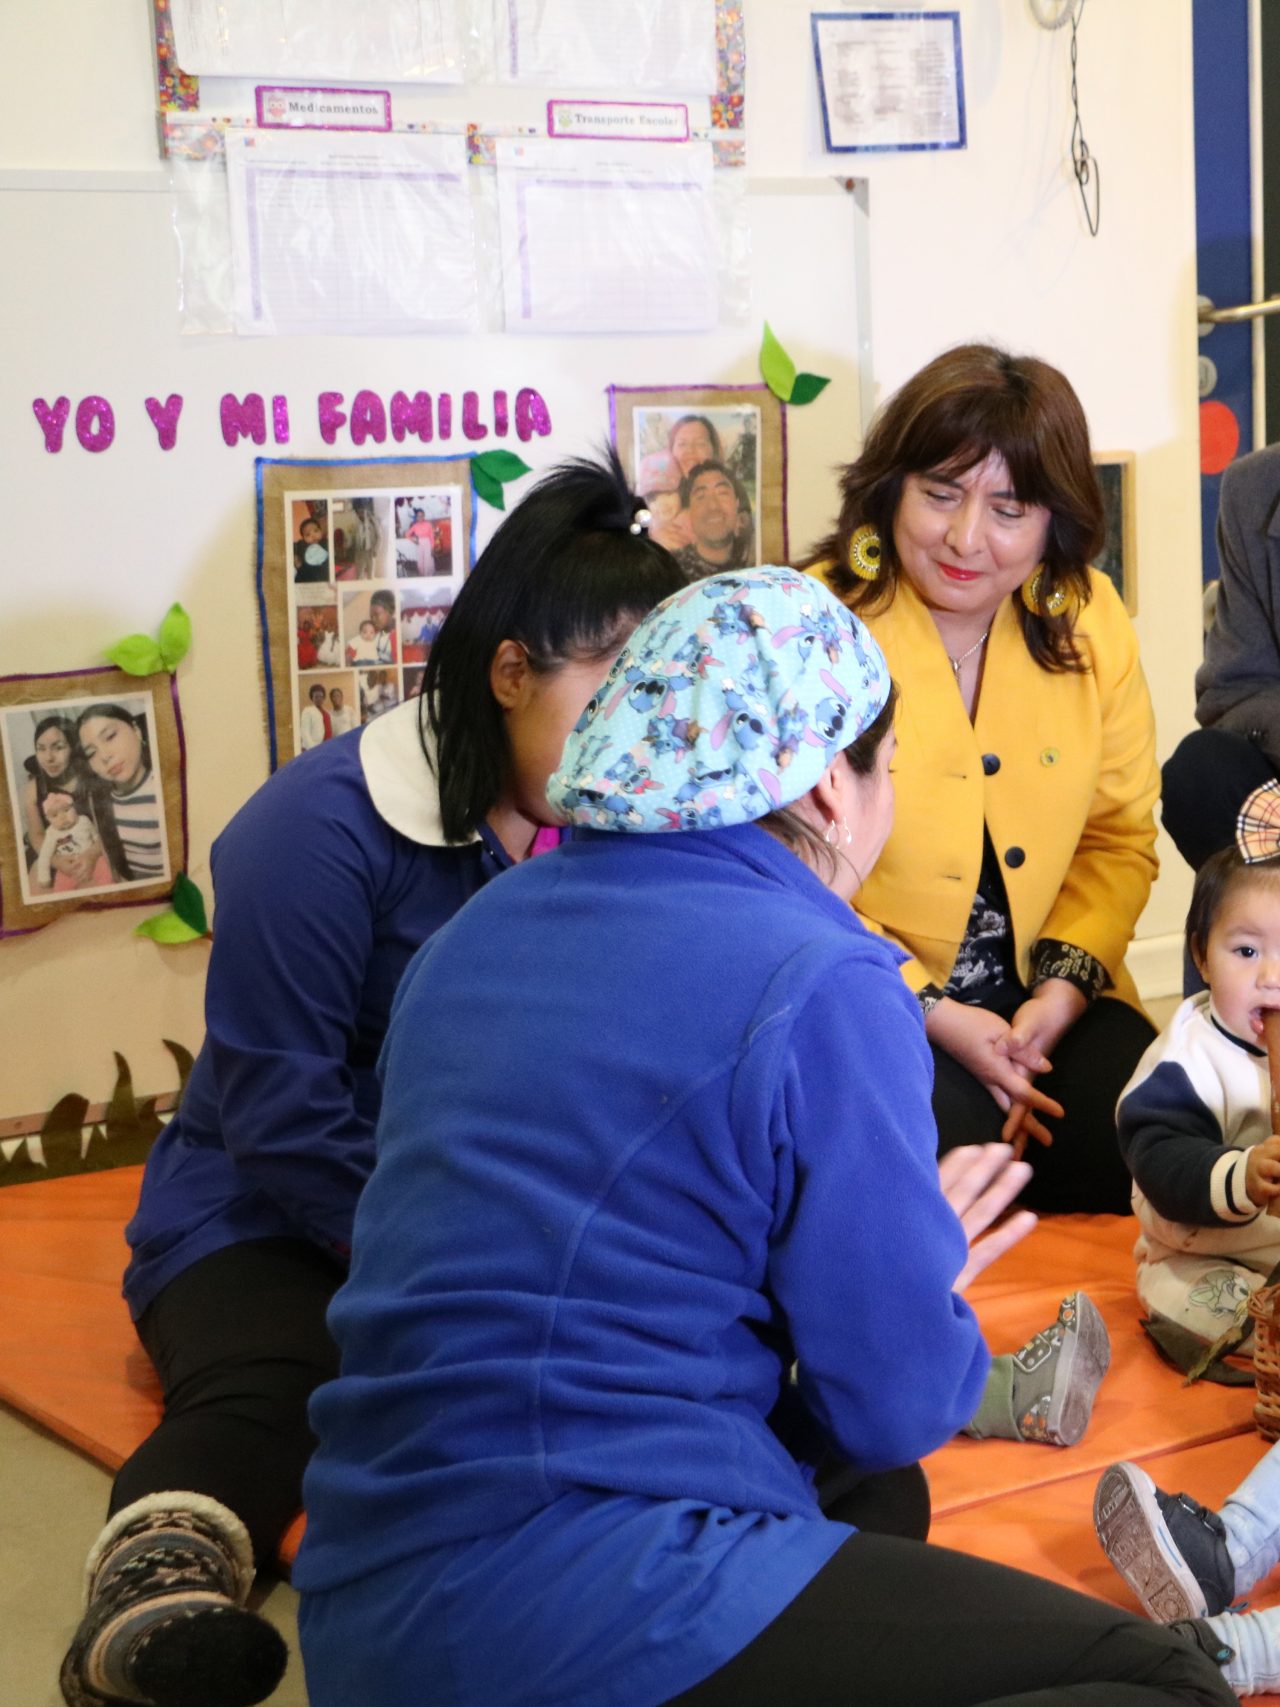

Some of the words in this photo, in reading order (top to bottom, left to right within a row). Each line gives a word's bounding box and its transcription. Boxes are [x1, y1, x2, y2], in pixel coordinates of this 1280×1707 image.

[32, 395, 115, 453] YO
[145, 394, 183, 451] Y
[220, 393, 289, 447] MI
[318, 389, 553, 446] FAMILIA
